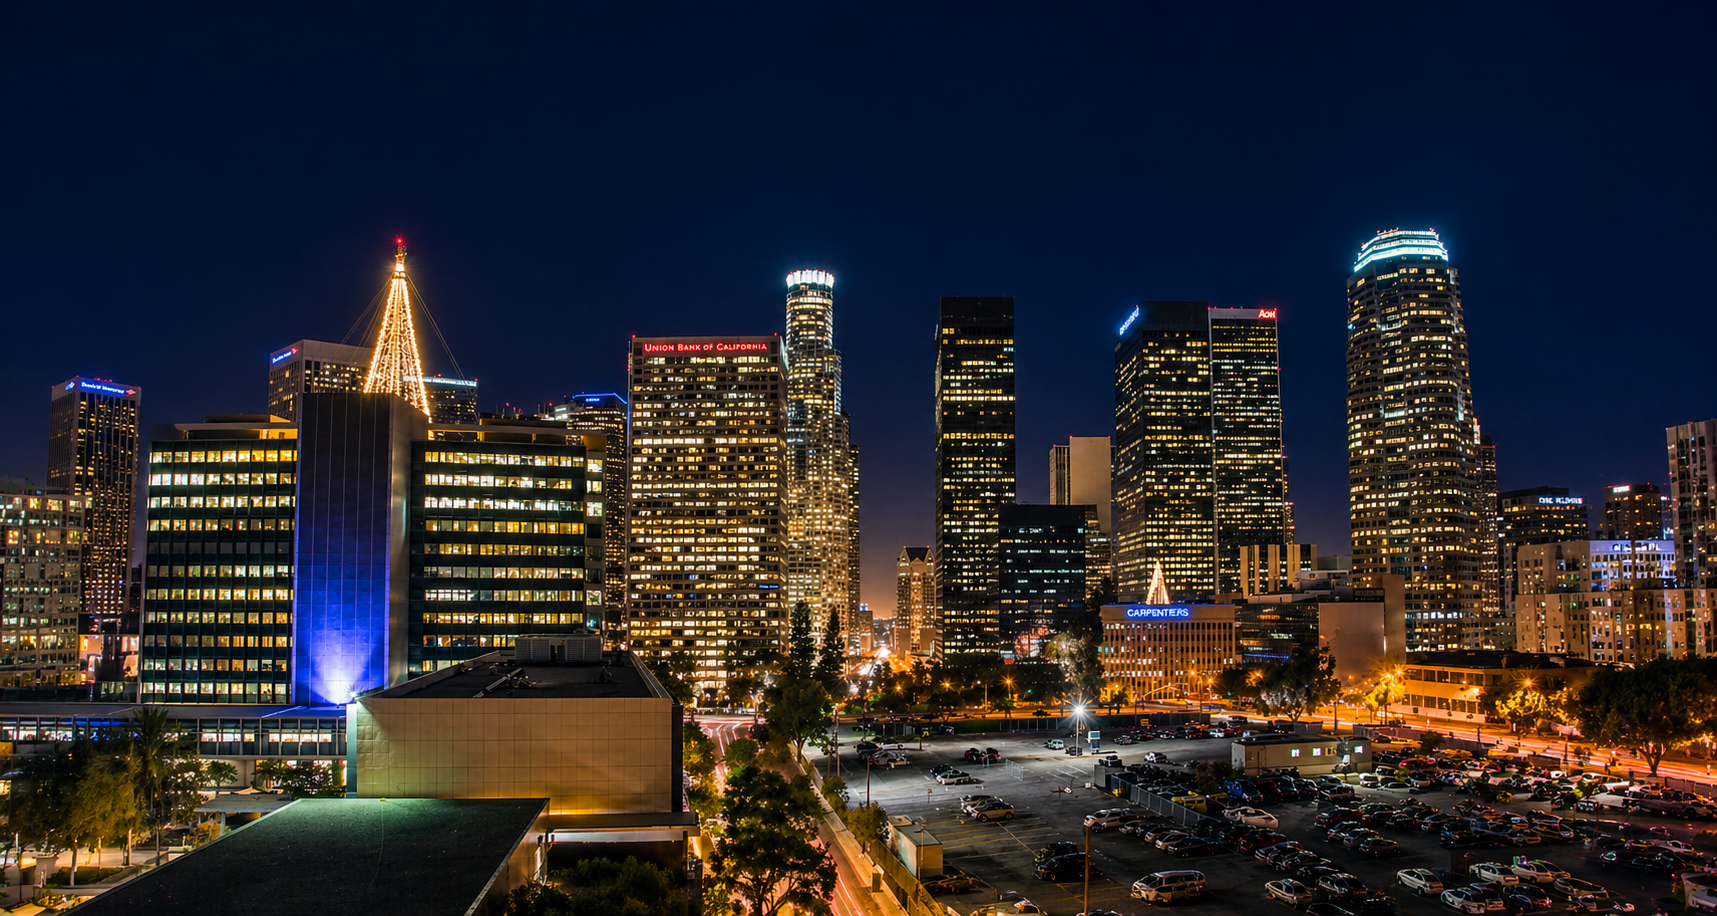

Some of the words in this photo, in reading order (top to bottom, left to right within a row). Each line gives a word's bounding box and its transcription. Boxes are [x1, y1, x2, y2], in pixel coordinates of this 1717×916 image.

[644, 343, 675, 352] UNION
[703, 343, 714, 351] OF
[716, 343, 768, 351] CALIFORNIA
[1126, 608, 1189, 617] CARPENTERS
